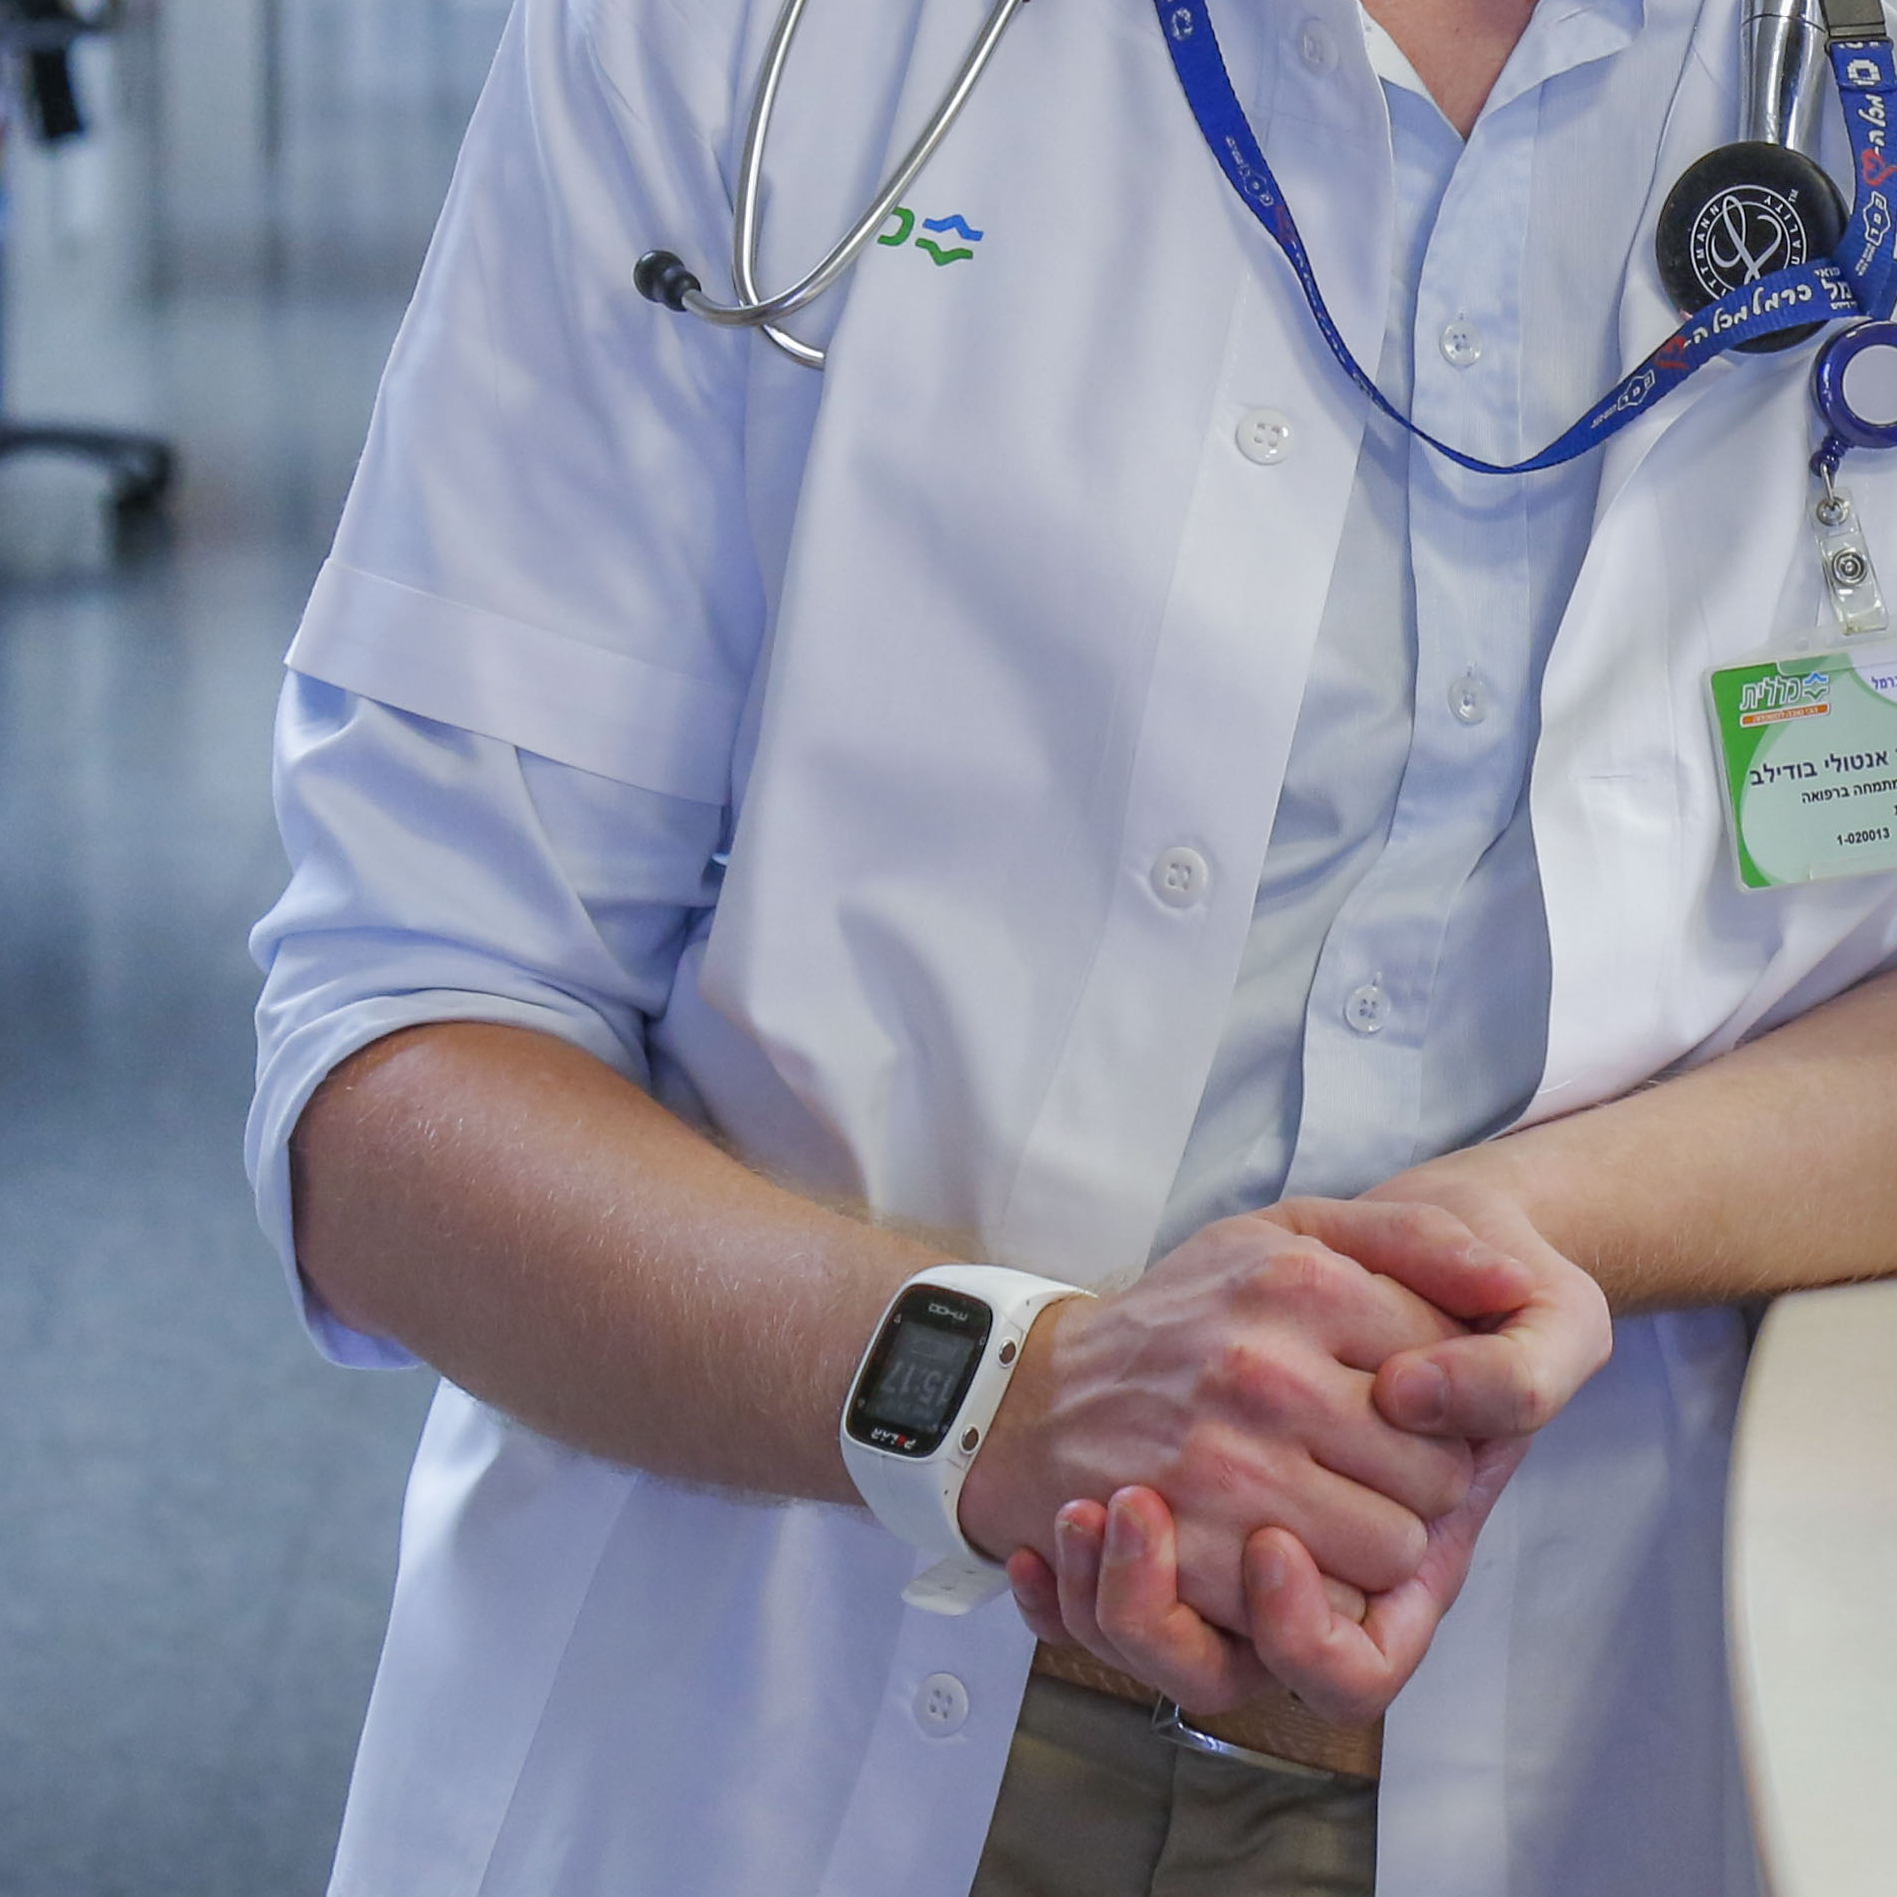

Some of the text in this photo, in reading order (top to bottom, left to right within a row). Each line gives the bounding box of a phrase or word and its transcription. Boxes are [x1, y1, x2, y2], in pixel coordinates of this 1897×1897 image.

[1752, 284, 1812, 315] כרמל
[1739, 675, 1801, 711] כללית
[1749, 761, 1818, 786] בודילב
[1824, 750, 1888, 774] אנטולי
[1802, 786, 1850, 803] ברפואה
[1836, 827, 1891, 846] 1-020013
[871, 1427, 917, 1450] POLAR
